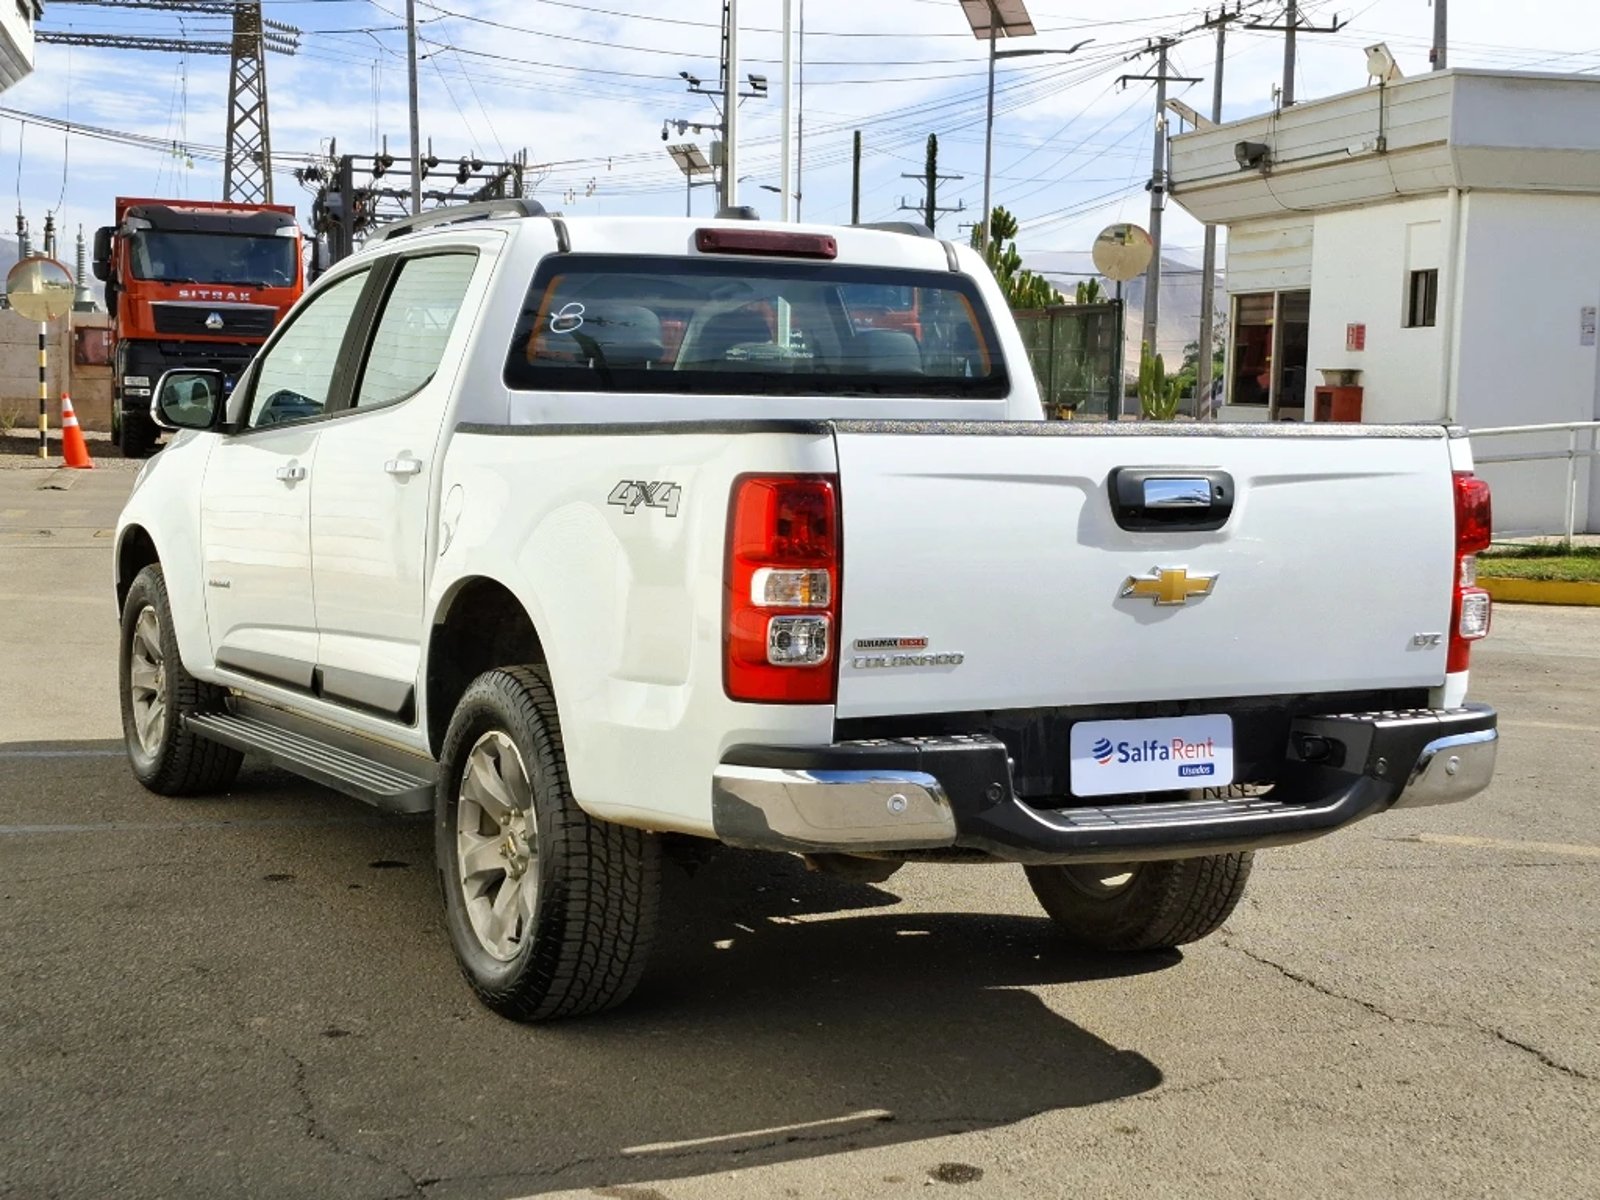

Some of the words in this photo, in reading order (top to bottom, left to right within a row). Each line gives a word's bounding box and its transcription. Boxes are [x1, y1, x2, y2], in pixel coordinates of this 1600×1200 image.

[179, 290, 250, 301] SITRAK
[857, 639, 898, 648] DURAMAX
[899, 638, 926, 647] DIESEL
[854, 652, 964, 668] COLORADO
[1182, 765, 1211, 776] Usados
